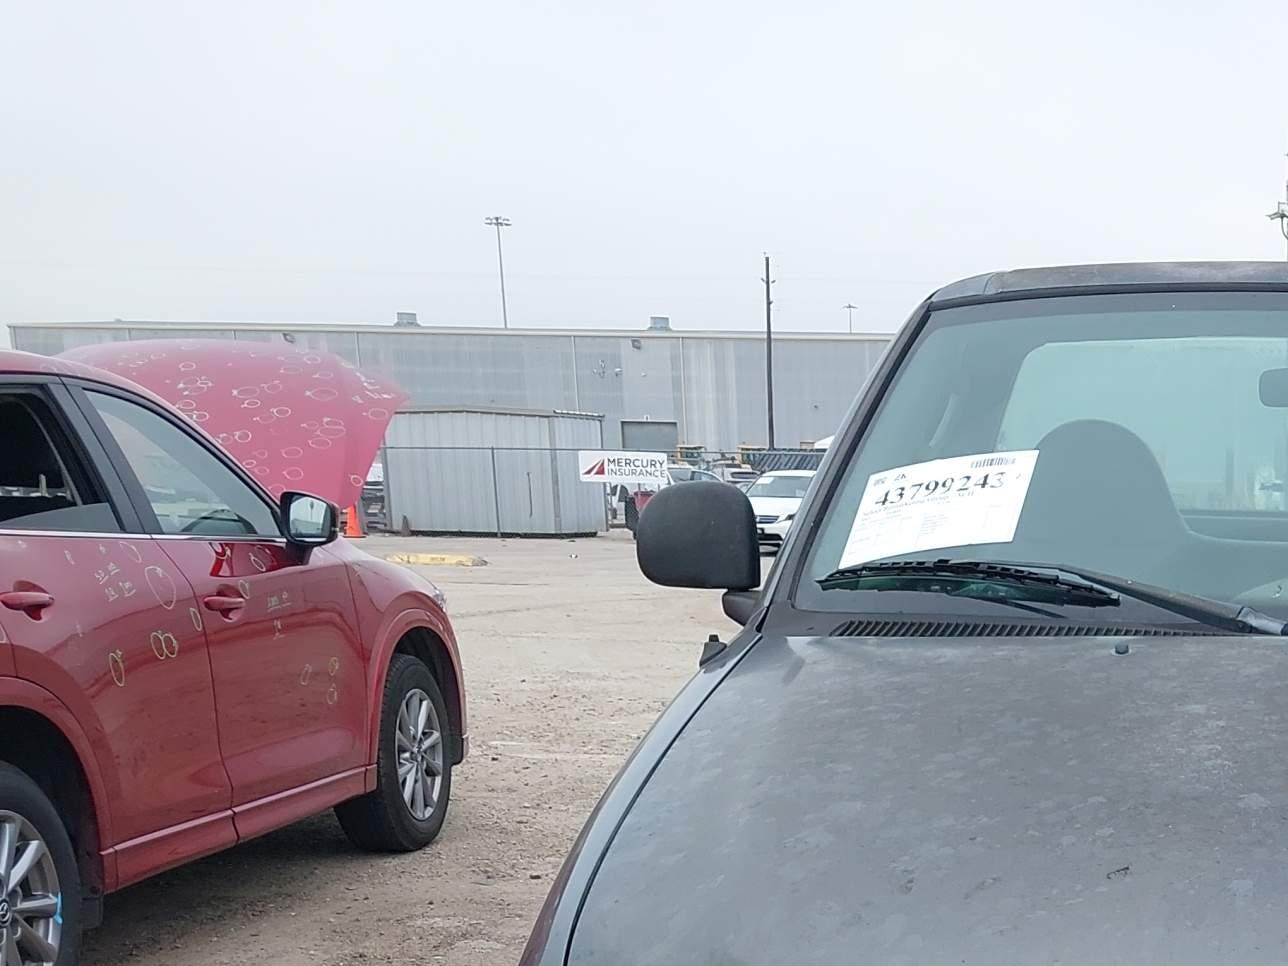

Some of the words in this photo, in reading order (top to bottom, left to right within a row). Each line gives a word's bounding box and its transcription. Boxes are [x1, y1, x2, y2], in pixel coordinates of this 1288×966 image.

[607, 457, 665, 468] MERCURY
[607, 467, 667, 478] INSURANCE
[875, 471, 1007, 506] 43799243
